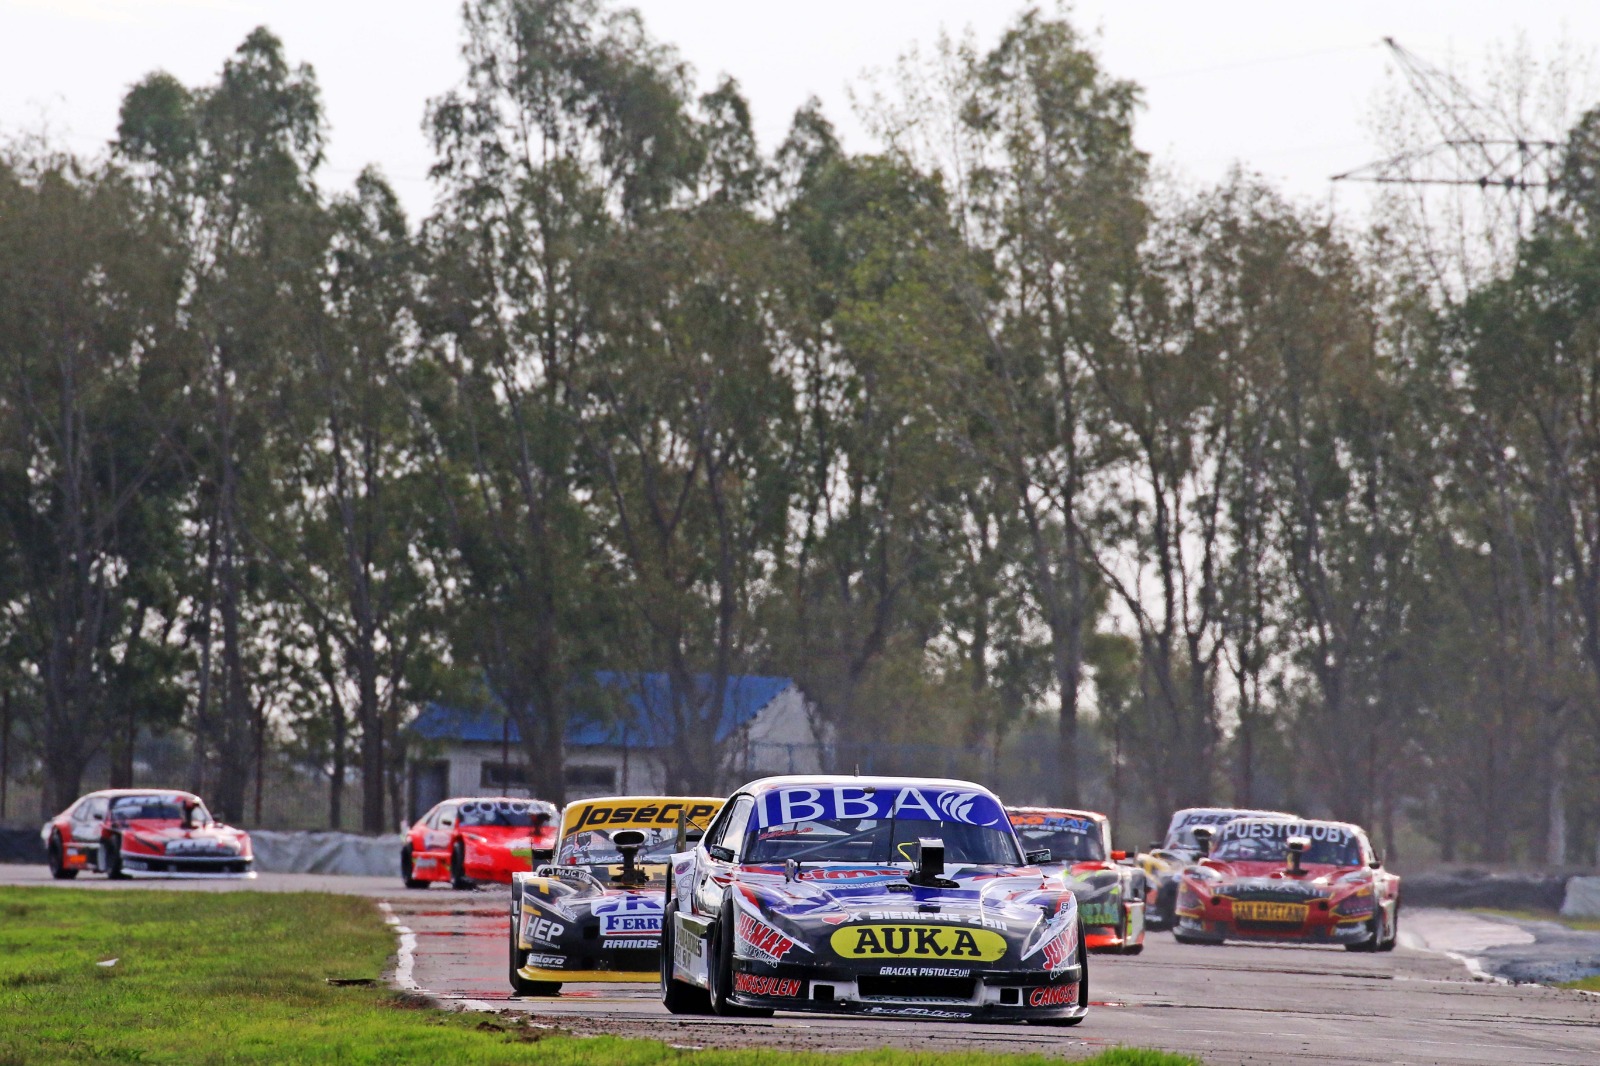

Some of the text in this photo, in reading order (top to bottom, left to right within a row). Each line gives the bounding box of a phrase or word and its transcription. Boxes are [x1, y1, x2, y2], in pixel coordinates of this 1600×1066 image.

[525, 915, 564, 942] HEP
[868, 911, 961, 923] SIEMPRE
[853, 928, 982, 956] AUKA
